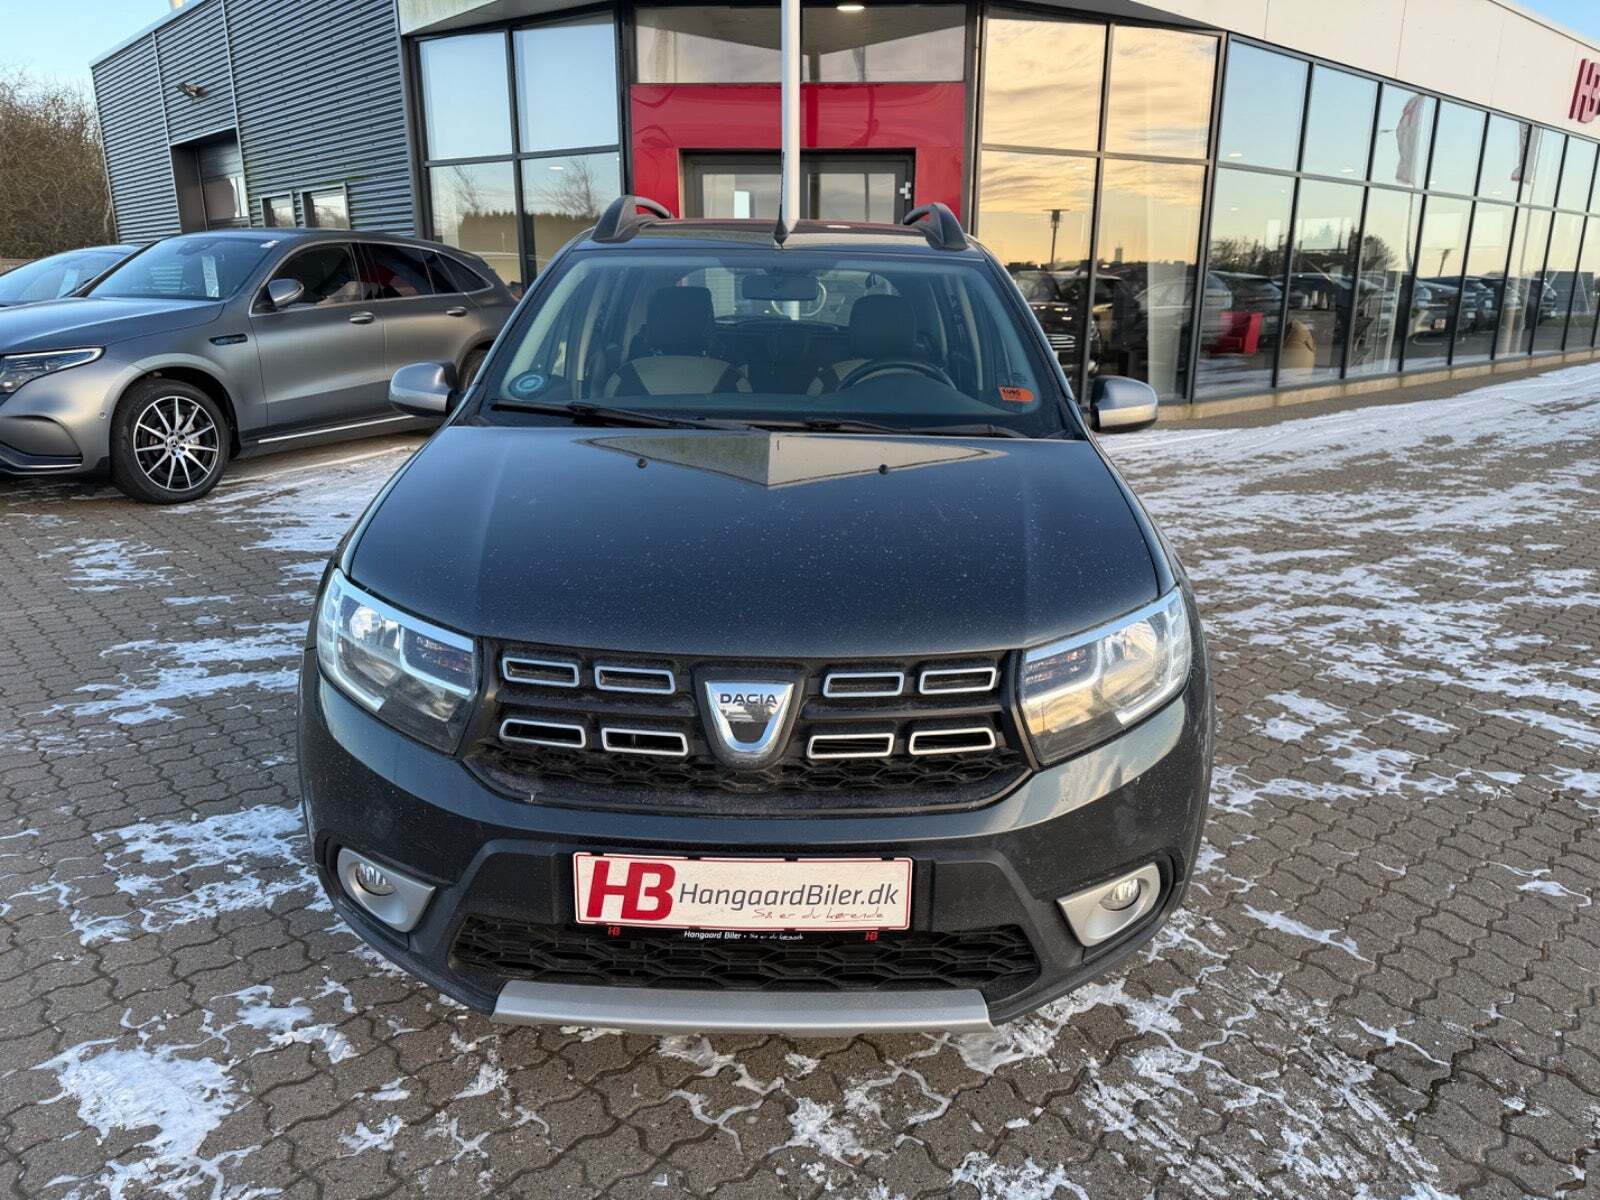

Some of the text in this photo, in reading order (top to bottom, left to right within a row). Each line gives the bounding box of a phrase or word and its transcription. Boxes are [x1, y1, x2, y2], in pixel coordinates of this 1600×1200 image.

[586, 860, 899, 921] HB HangaardBiler.dk
[608, 926, 621, 936] HB
[684, 930, 721, 940] Hangaard
[725, 931, 742, 940] Biler
